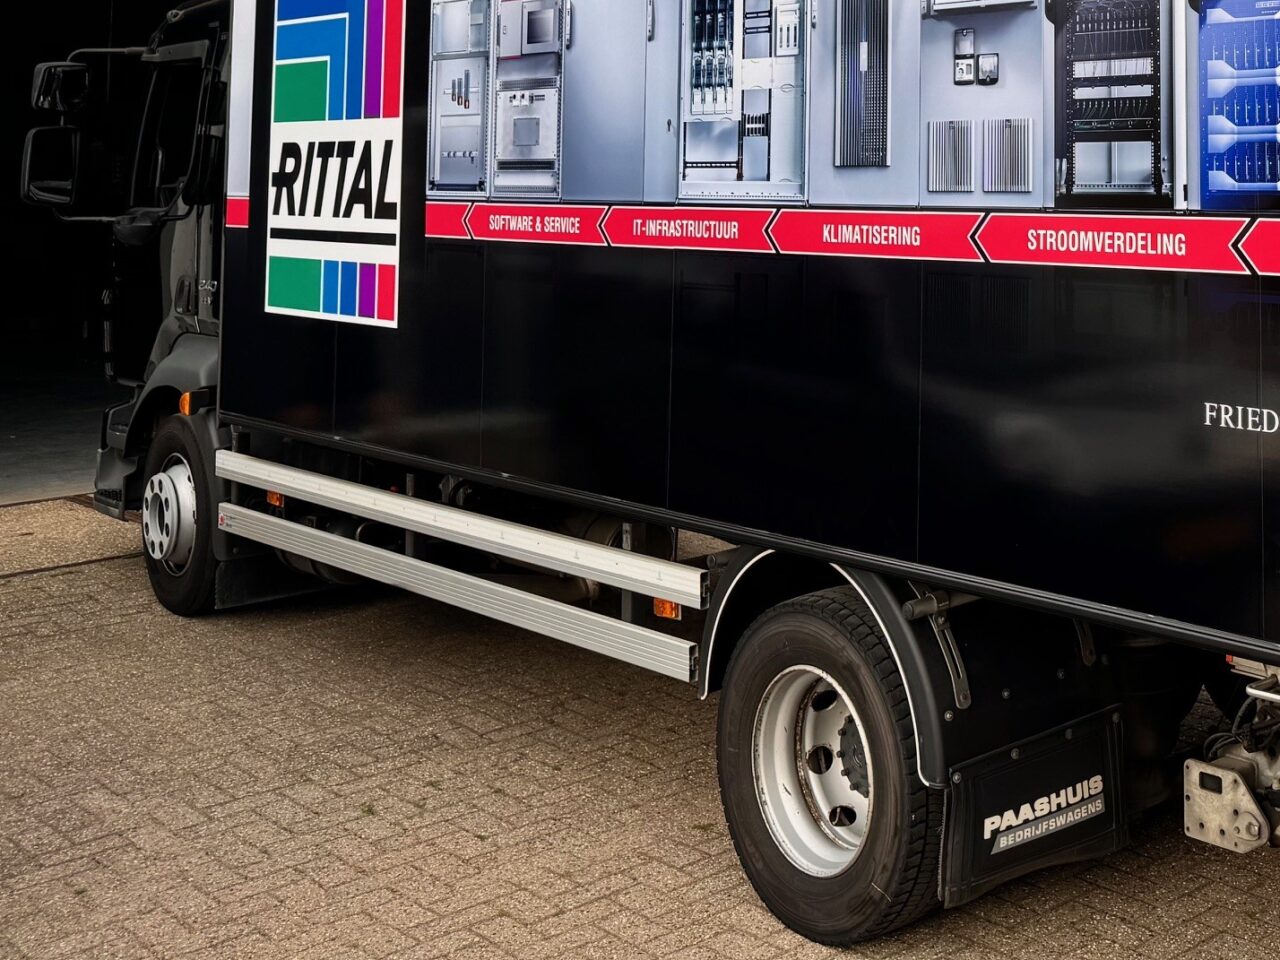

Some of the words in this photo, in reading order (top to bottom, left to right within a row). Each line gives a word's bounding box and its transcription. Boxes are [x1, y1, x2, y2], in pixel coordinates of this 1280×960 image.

[271, 140, 398, 220] RITTAL
[489, 214, 533, 234] SOFTWARE
[534, 216, 542, 233] &
[544, 216, 580, 235] SERVICE
[632, 218, 739, 240] IT-INFRASTRUCTUUR
[822, 223, 922, 247] KLIMATISERING
[1027, 228, 1187, 257] STROOMVERDELING
[983, 774, 1104, 840] PAASHUIS
[1000, 799, 1103, 848] BEDRIJFSWAGENS
